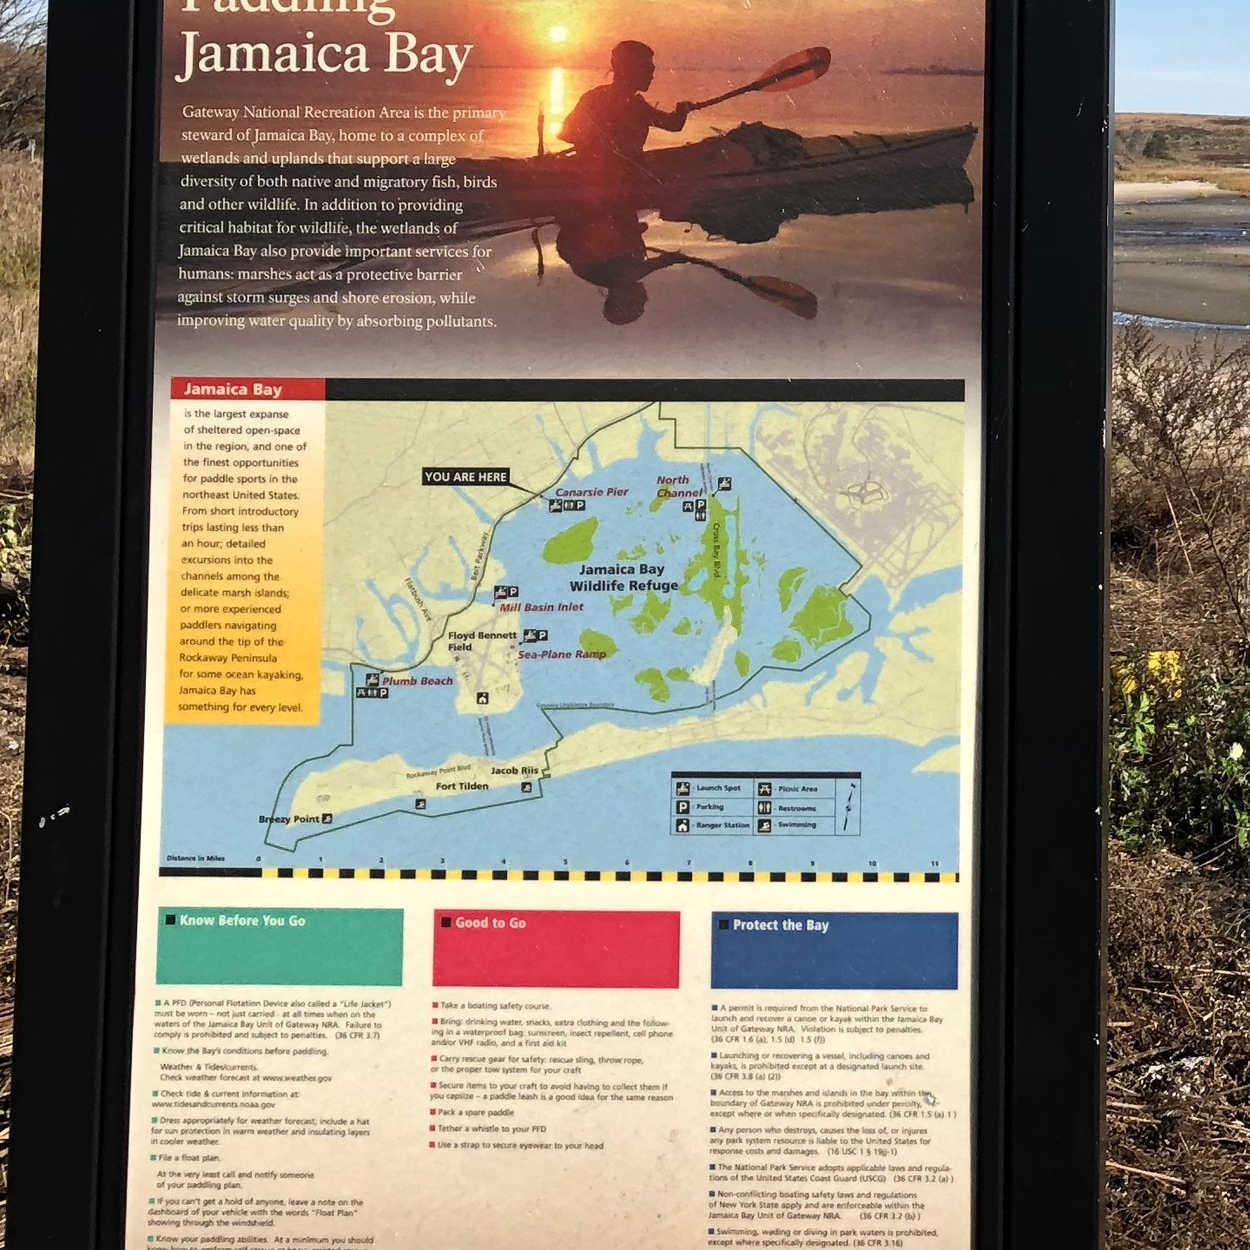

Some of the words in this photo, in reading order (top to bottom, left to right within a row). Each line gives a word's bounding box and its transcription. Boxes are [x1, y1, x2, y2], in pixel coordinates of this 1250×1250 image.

[174, 31, 370, 83] Jamaica
[384, 32, 474, 86] Bay
[183, 105, 239, 121] Gateway
[244, 106, 300, 119] National
[304, 106, 375, 119] Recreation
[379, 107, 410, 119] Area
[414, 107, 424, 119] is
[428, 107, 449, 119] the
[453, 107, 506, 122] primary
[180, 175, 235, 190] diversity
[239, 175, 254, 188] of
[257, 175, 288, 188] both
[292, 176, 331, 188] native
[335, 176, 359, 188] and
[364, 177, 428, 191] migratory
[432, 176, 460, 190] fish,
[463, 176, 497, 188] birds
[177, 315, 245, 330] improving
[249, 316, 285, 327] water
[289, 316, 334, 330] quality
[337, 316, 352, 330] by
[356, 316, 423, 331] absorbing
[426, 316, 497, 331] pollutants.
[184, 383, 248, 396] Jamaica
[253, 383, 282, 398] Bay
[185, 409, 192, 418] is
[195, 409, 210, 418] the
[214, 410, 246, 420] largest
[249, 411, 289, 420] expanse
[184, 458, 199, 466] the
[203, 458, 229, 467] finest
[233, 458, 299, 468] opportunities
[425, 472, 451, 482] YOU
[454, 472, 475, 482] ARE
[478, 472, 507, 482] HERE
[657, 476, 689, 484] North
[183, 490, 229, 499] northeast
[233, 491, 265, 499] United
[268, 491, 300, 500] States.
[556, 488, 604, 497] Canarsie
[607, 488, 629, 497] Pier
[657, 489, 703, 498] Channel
[182, 507, 207, 515] From
[210, 507, 235, 516] short
[238, 507, 299, 518] introductory
[474, 531, 490, 564] Parkway
[579, 564, 635, 575] Jamaica
[639, 564, 665, 577] Bay
[570, 581, 625, 591] Wildlife
[629, 581, 679, 593] Refuge
[181, 588, 219, 597] delicate
[222, 588, 251, 597] marsh
[255, 589, 289, 598] islands;
[404, 577, 425, 608] Flatbush
[421, 608, 432, 622] Ave
[500, 603, 520, 612] Mill
[524, 603, 554, 612] Basin
[557, 603, 584, 612] Inlet
[180, 621, 222, 630] paddlers
[225, 622, 277, 632] navigating
[448, 632, 475, 641] Floyd
[478, 632, 517, 640] Bennett
[179, 653, 228, 664] Rockaway
[231, 654, 277, 663] Peninsula
[518, 650, 572, 659] Sea-Plane
[575, 651, 607, 661] Ramp
[382, 677, 417, 686] Plumb
[421, 677, 453, 686] Beach
[179, 686, 217, 695] Jamaica
[220, 686, 237, 696] Bay
[240, 687, 256, 695] has
[178, 702, 229, 713] something
[233, 703, 246, 711] for
[250, 704, 275, 714] every
[279, 703, 303, 712] level.
[405, 770, 438, 779] Rockaway
[491, 766, 518, 775] Jacob
[521, 766, 539, 775] Riis
[436, 782, 454, 791] Fort
[457, 781, 489, 791] Tilden
[259, 815, 291, 825] Breezy
[294, 815, 320, 824] Point
[778, 821, 816, 829] Swimming
[180, 915, 214, 926] Know
[219, 915, 259, 927] Before
[262, 915, 285, 927] You
[288, 916, 306, 927] Go
[456, 917, 489, 929] Good
[492, 918, 506, 929] to
[509, 918, 526, 929] Go
[733, 919, 778, 931] Protect
[782, 919, 802, 931] the
[807, 919, 829, 934] Bay
[441, 1002, 458, 1010] Take
[468, 1002, 497, 1011] boating
[500, 1002, 523, 1012] safety
[729, 1005, 754, 1014] permit
[764, 1005, 797, 1014] required
[891, 1005, 917, 1013] Service
[438, 1108, 455, 1116] Pack
[488, 1109, 514, 1118] paddle
